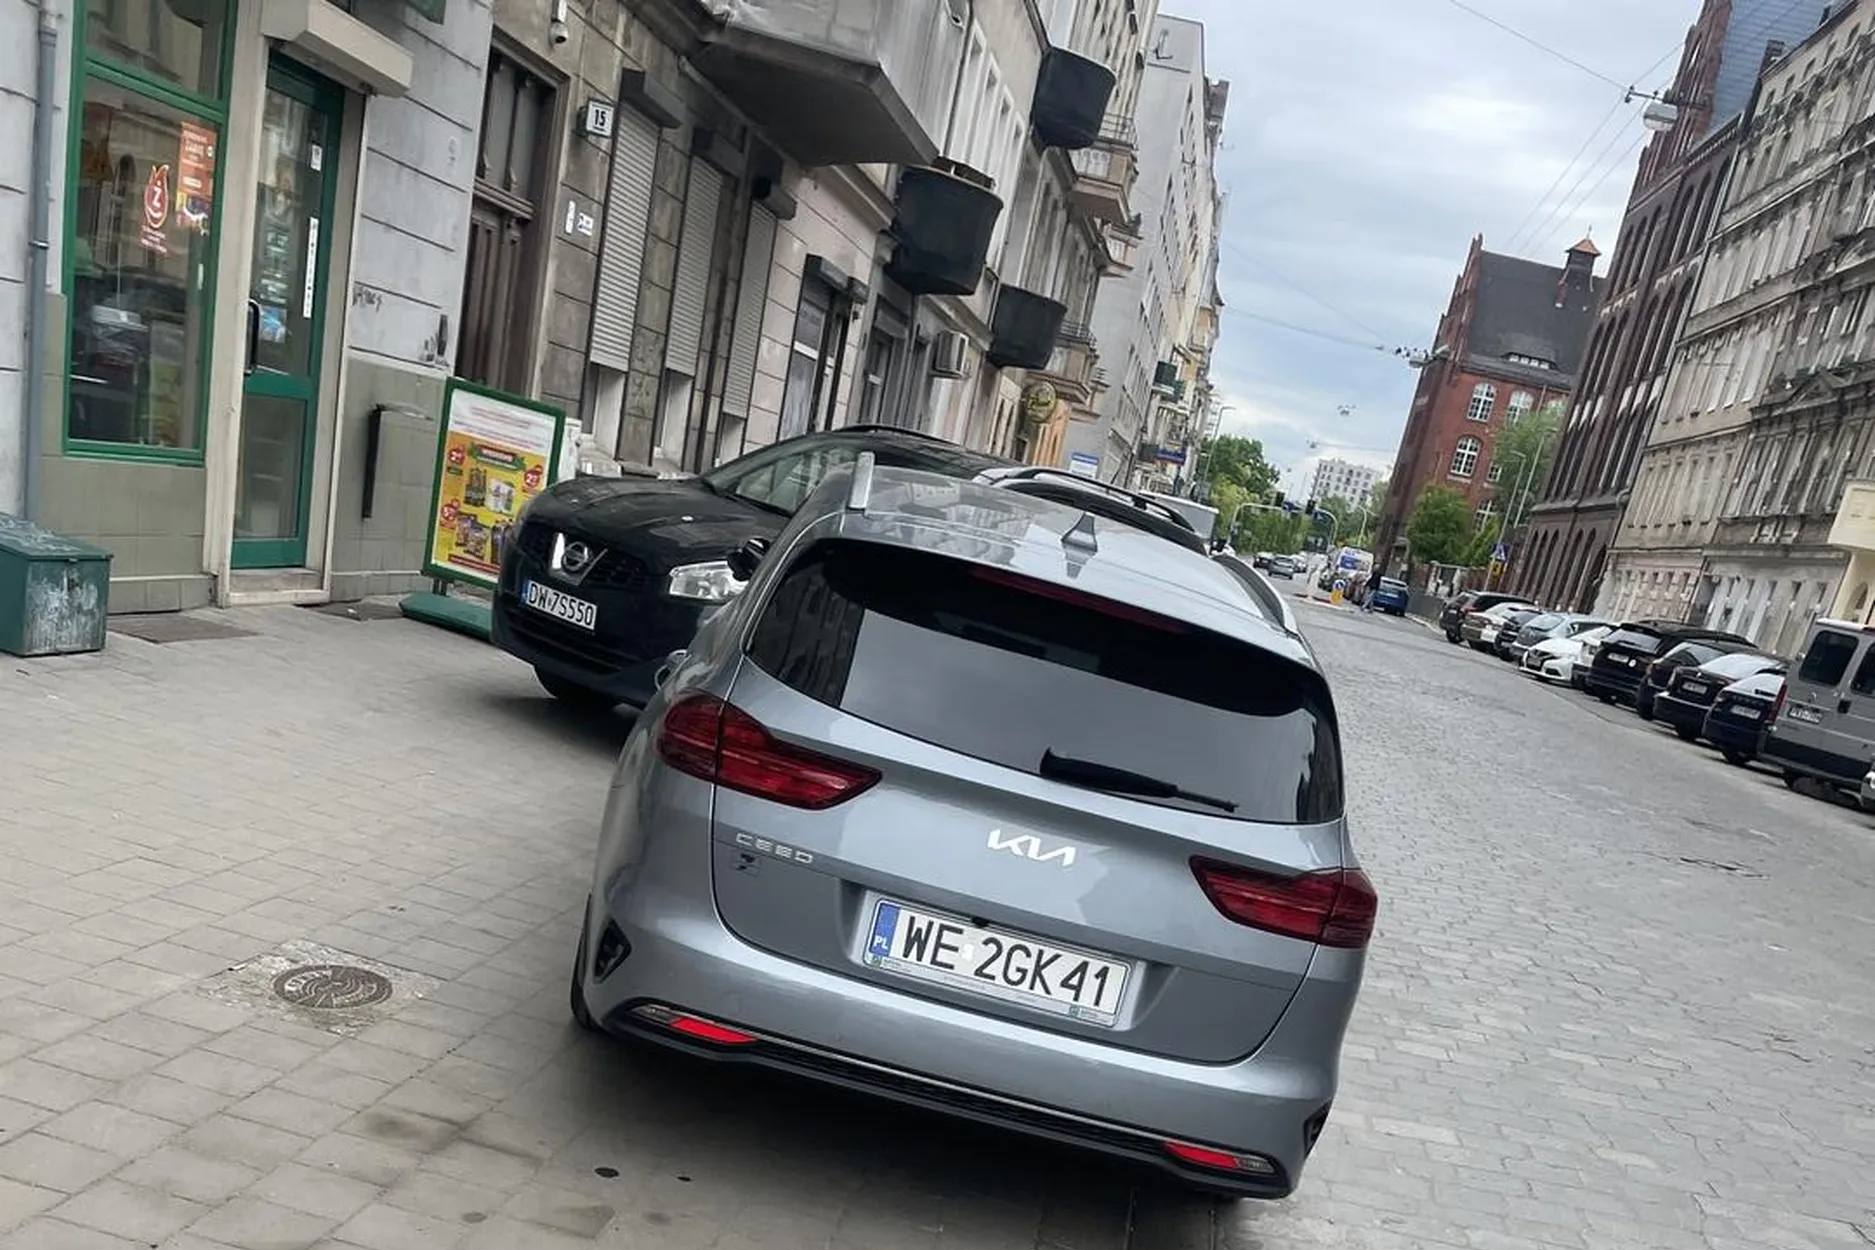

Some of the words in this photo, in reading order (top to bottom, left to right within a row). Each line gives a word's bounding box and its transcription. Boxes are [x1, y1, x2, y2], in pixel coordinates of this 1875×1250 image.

[594, 109, 606, 127] 15
[529, 583, 547, 609] DW
[735, 832, 814, 864] CEED
[873, 936, 889, 949] PL
[902, 916, 964, 970] WE
[973, 937, 1110, 1007] 2GK41
